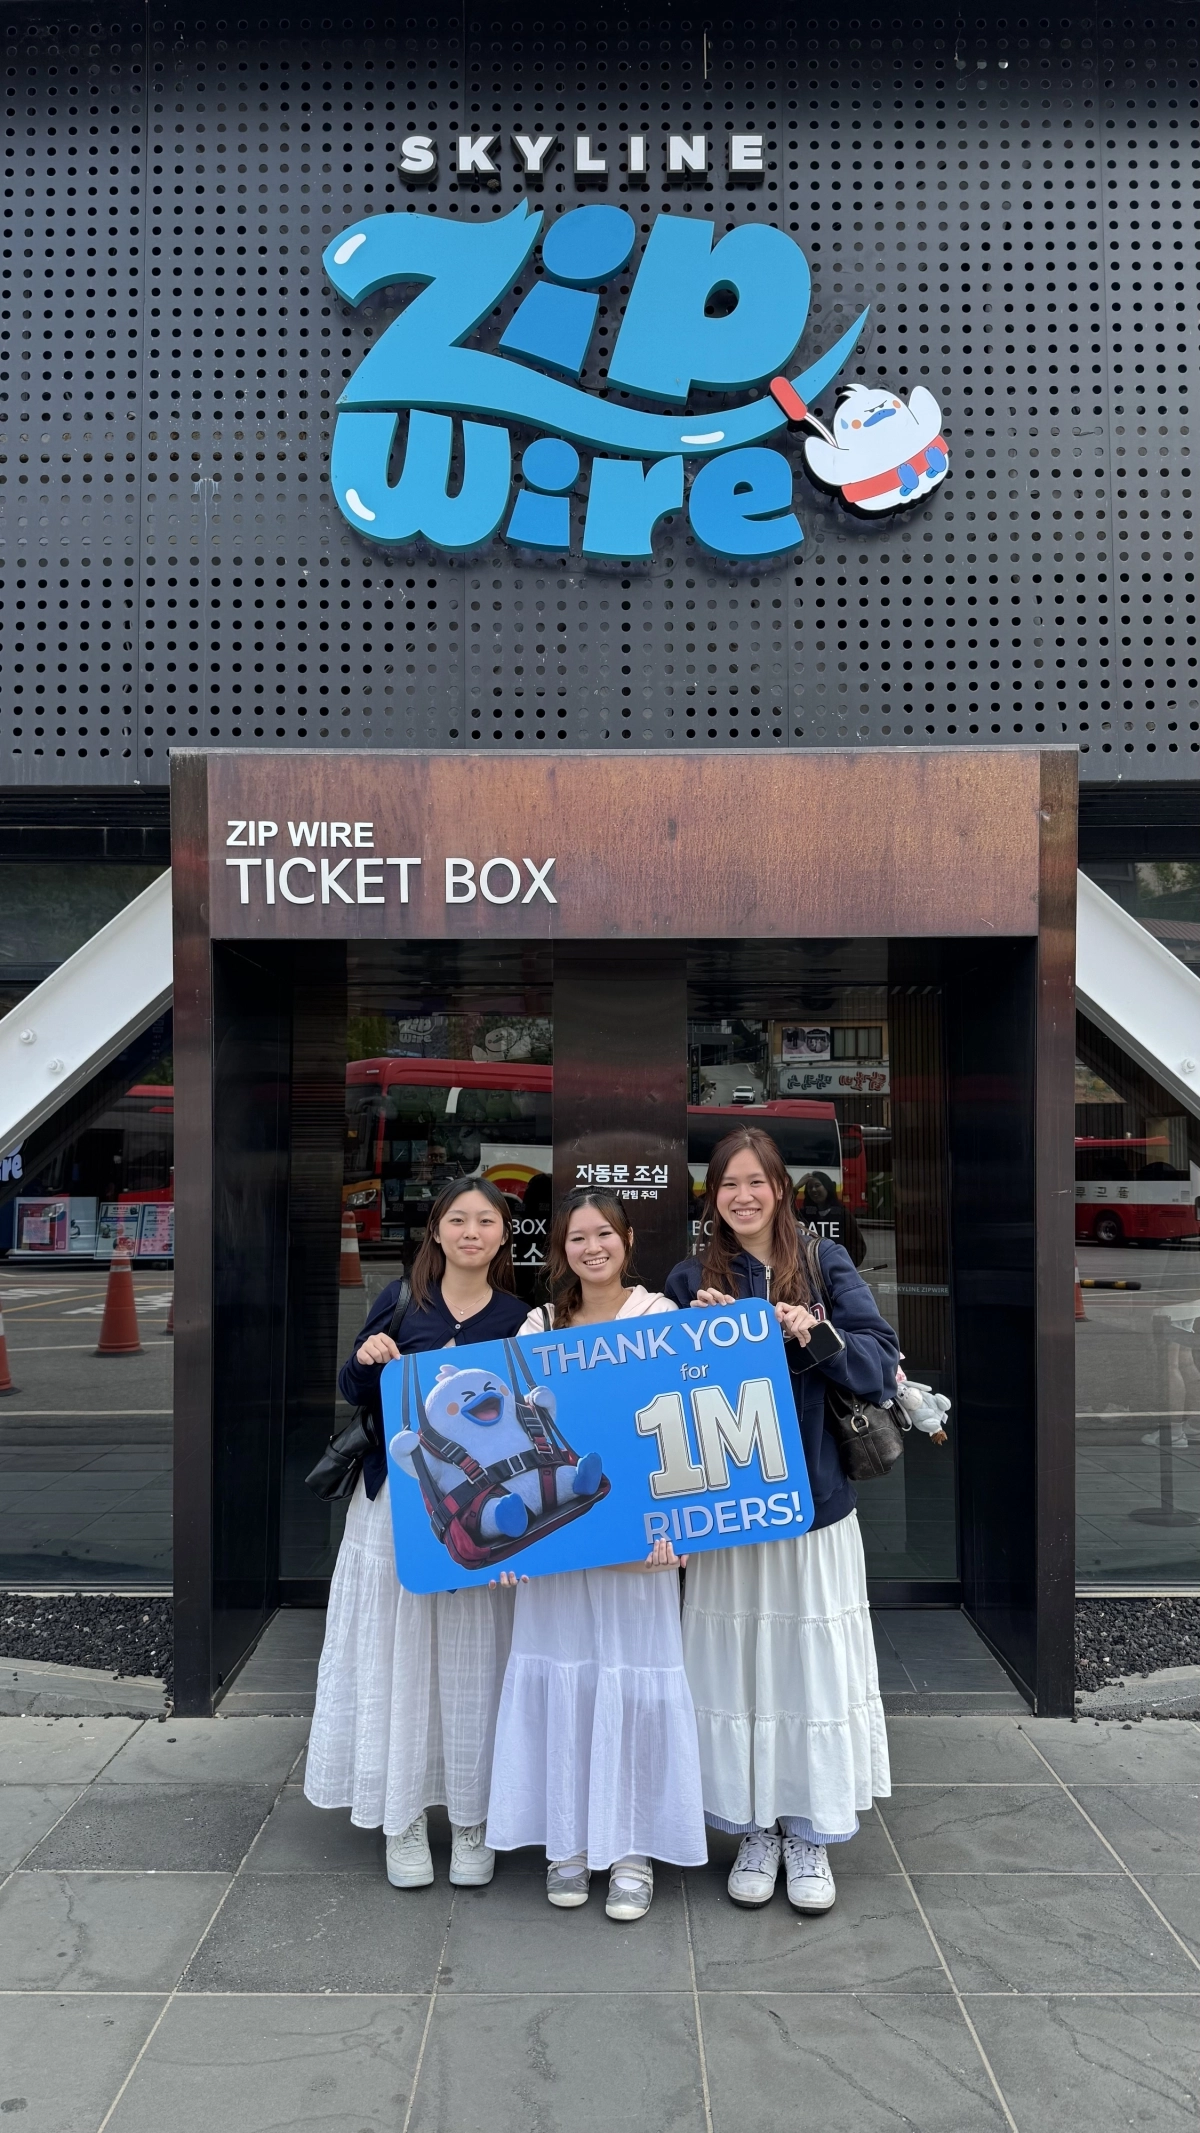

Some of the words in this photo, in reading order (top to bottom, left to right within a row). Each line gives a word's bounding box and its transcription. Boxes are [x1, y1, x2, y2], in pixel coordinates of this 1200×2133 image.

[400, 135, 767, 180] SKYLINE
[323, 197, 870, 457] Zip
[226, 820, 278, 847] ZIP
[288, 821, 375, 848] WIRE
[226, 857, 422, 905] TICKET
[445, 857, 558, 905] BOX
[575, 1163, 630, 1183] 자동문
[633, 1163, 668, 1184] 조심
[640, 1189, 658, 1200] 주의
[532, 1325, 678, 1376] THANK
[681, 1310, 770, 1353] YOU
[680, 1360, 709, 1381] for
[635, 1377, 788, 1500] 1M
[643, 1490, 805, 1546] RIDERS!
